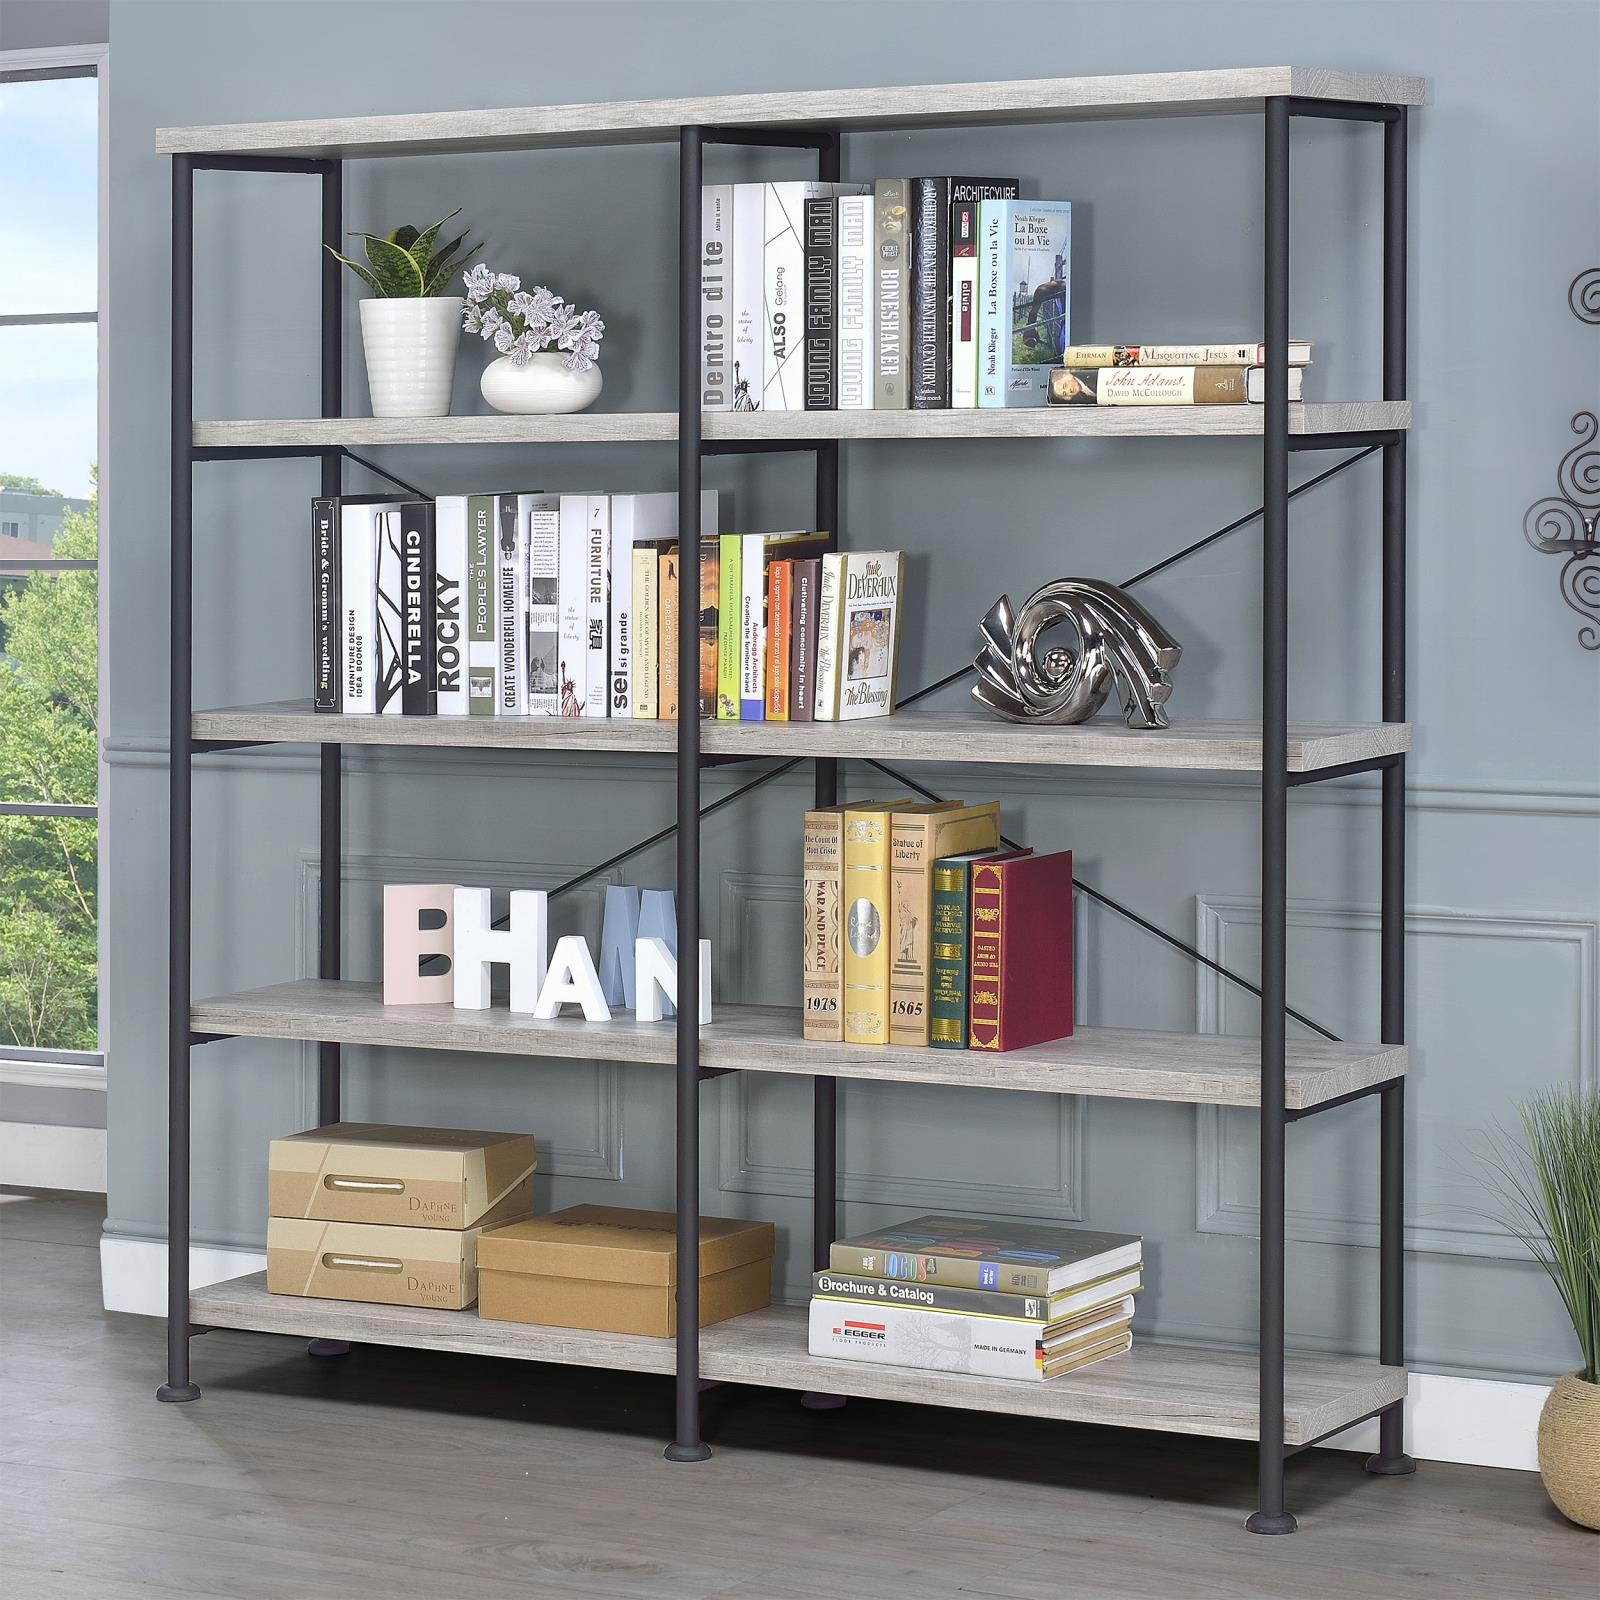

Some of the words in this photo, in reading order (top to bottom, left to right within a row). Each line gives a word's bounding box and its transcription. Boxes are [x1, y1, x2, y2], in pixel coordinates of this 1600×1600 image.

[808, 202, 832, 246] MAN
[842, 202, 864, 246] MAN
[990, 218, 998, 242] Vie
[1014, 223, 1026, 233] La
[1028, 224, 1048, 234] Boxe
[704, 241, 723, 266] te
[990, 244, 998, 256] la
[1028, 236, 1034, 245] la
[1037, 236, 1050, 246] Vie
[922, 258, 936, 268] IN
[992, 258, 998, 272] ou
[703, 276, 723, 300] di
[774, 266, 785, 306] Gelang
[922, 270, 936, 287] THE
[988, 274, 997, 300] Boxe
[808, 256, 832, 330] FAMILY
[842, 256, 864, 329] FAMILY
[922, 290, 936, 342] TWENTIETH
[988, 302, 996, 315] La
[880, 268, 900, 376] BONESHAKER
[774, 312, 786, 360] ALSO
[988, 328, 998, 354] Klieger
[704, 314, 724, 405] Dentro
[922, 344, 936, 386] CENTURY
[988, 355, 996, 376] Noah
[1106, 370, 1134, 386] John
[594, 508, 600, 518] 7
[320, 519, 329, 556] Bride
[477, 510, 486, 566] LAWYER
[320, 558, 329, 570] &
[590, 528, 602, 604] FURNITURE
[502, 567, 514, 612] HOMELIFE
[848, 574, 896, 600] DEVERAUX
[320, 572, 330, 630] Gromm's
[406, 531, 422, 684] CINDERELLA
[476, 570, 487, 634] PEOPLE'S
[664, 598, 672, 632] CARLOS
[437, 572, 460, 692] ROCKY
[504, 615, 516, 672] WONDERFUL
[619, 612, 629, 654] grande
[664, 634, 672, 656] RUIZ
[320, 636, 330, 690] wedding
[618, 658, 627, 668] si
[504, 676, 516, 708] CREATE
[844, 688, 859, 706] The
[858, 682, 888, 708] Blessing
[820, 847, 836, 855] Cristo
[893, 838, 913, 848] Statue
[915, 838, 923, 848] of
[895, 850, 920, 861] Liberty
[816, 881, 826, 910] WAR
[816, 911, 826, 936] AND
[816, 938, 826, 970] PEACE
[806, 997, 837, 1011] 1978
[892, 1001, 923, 1016] 1865
[819, 1276, 875, 1295] Brochure
[878, 1284, 887, 1296] &
[890, 1286, 934, 1304] Catalog
[845, 1329, 886, 1340] EGGER
[974, 1344, 991, 1352] MADE
[998, 1346, 1027, 1355] GERMANY
